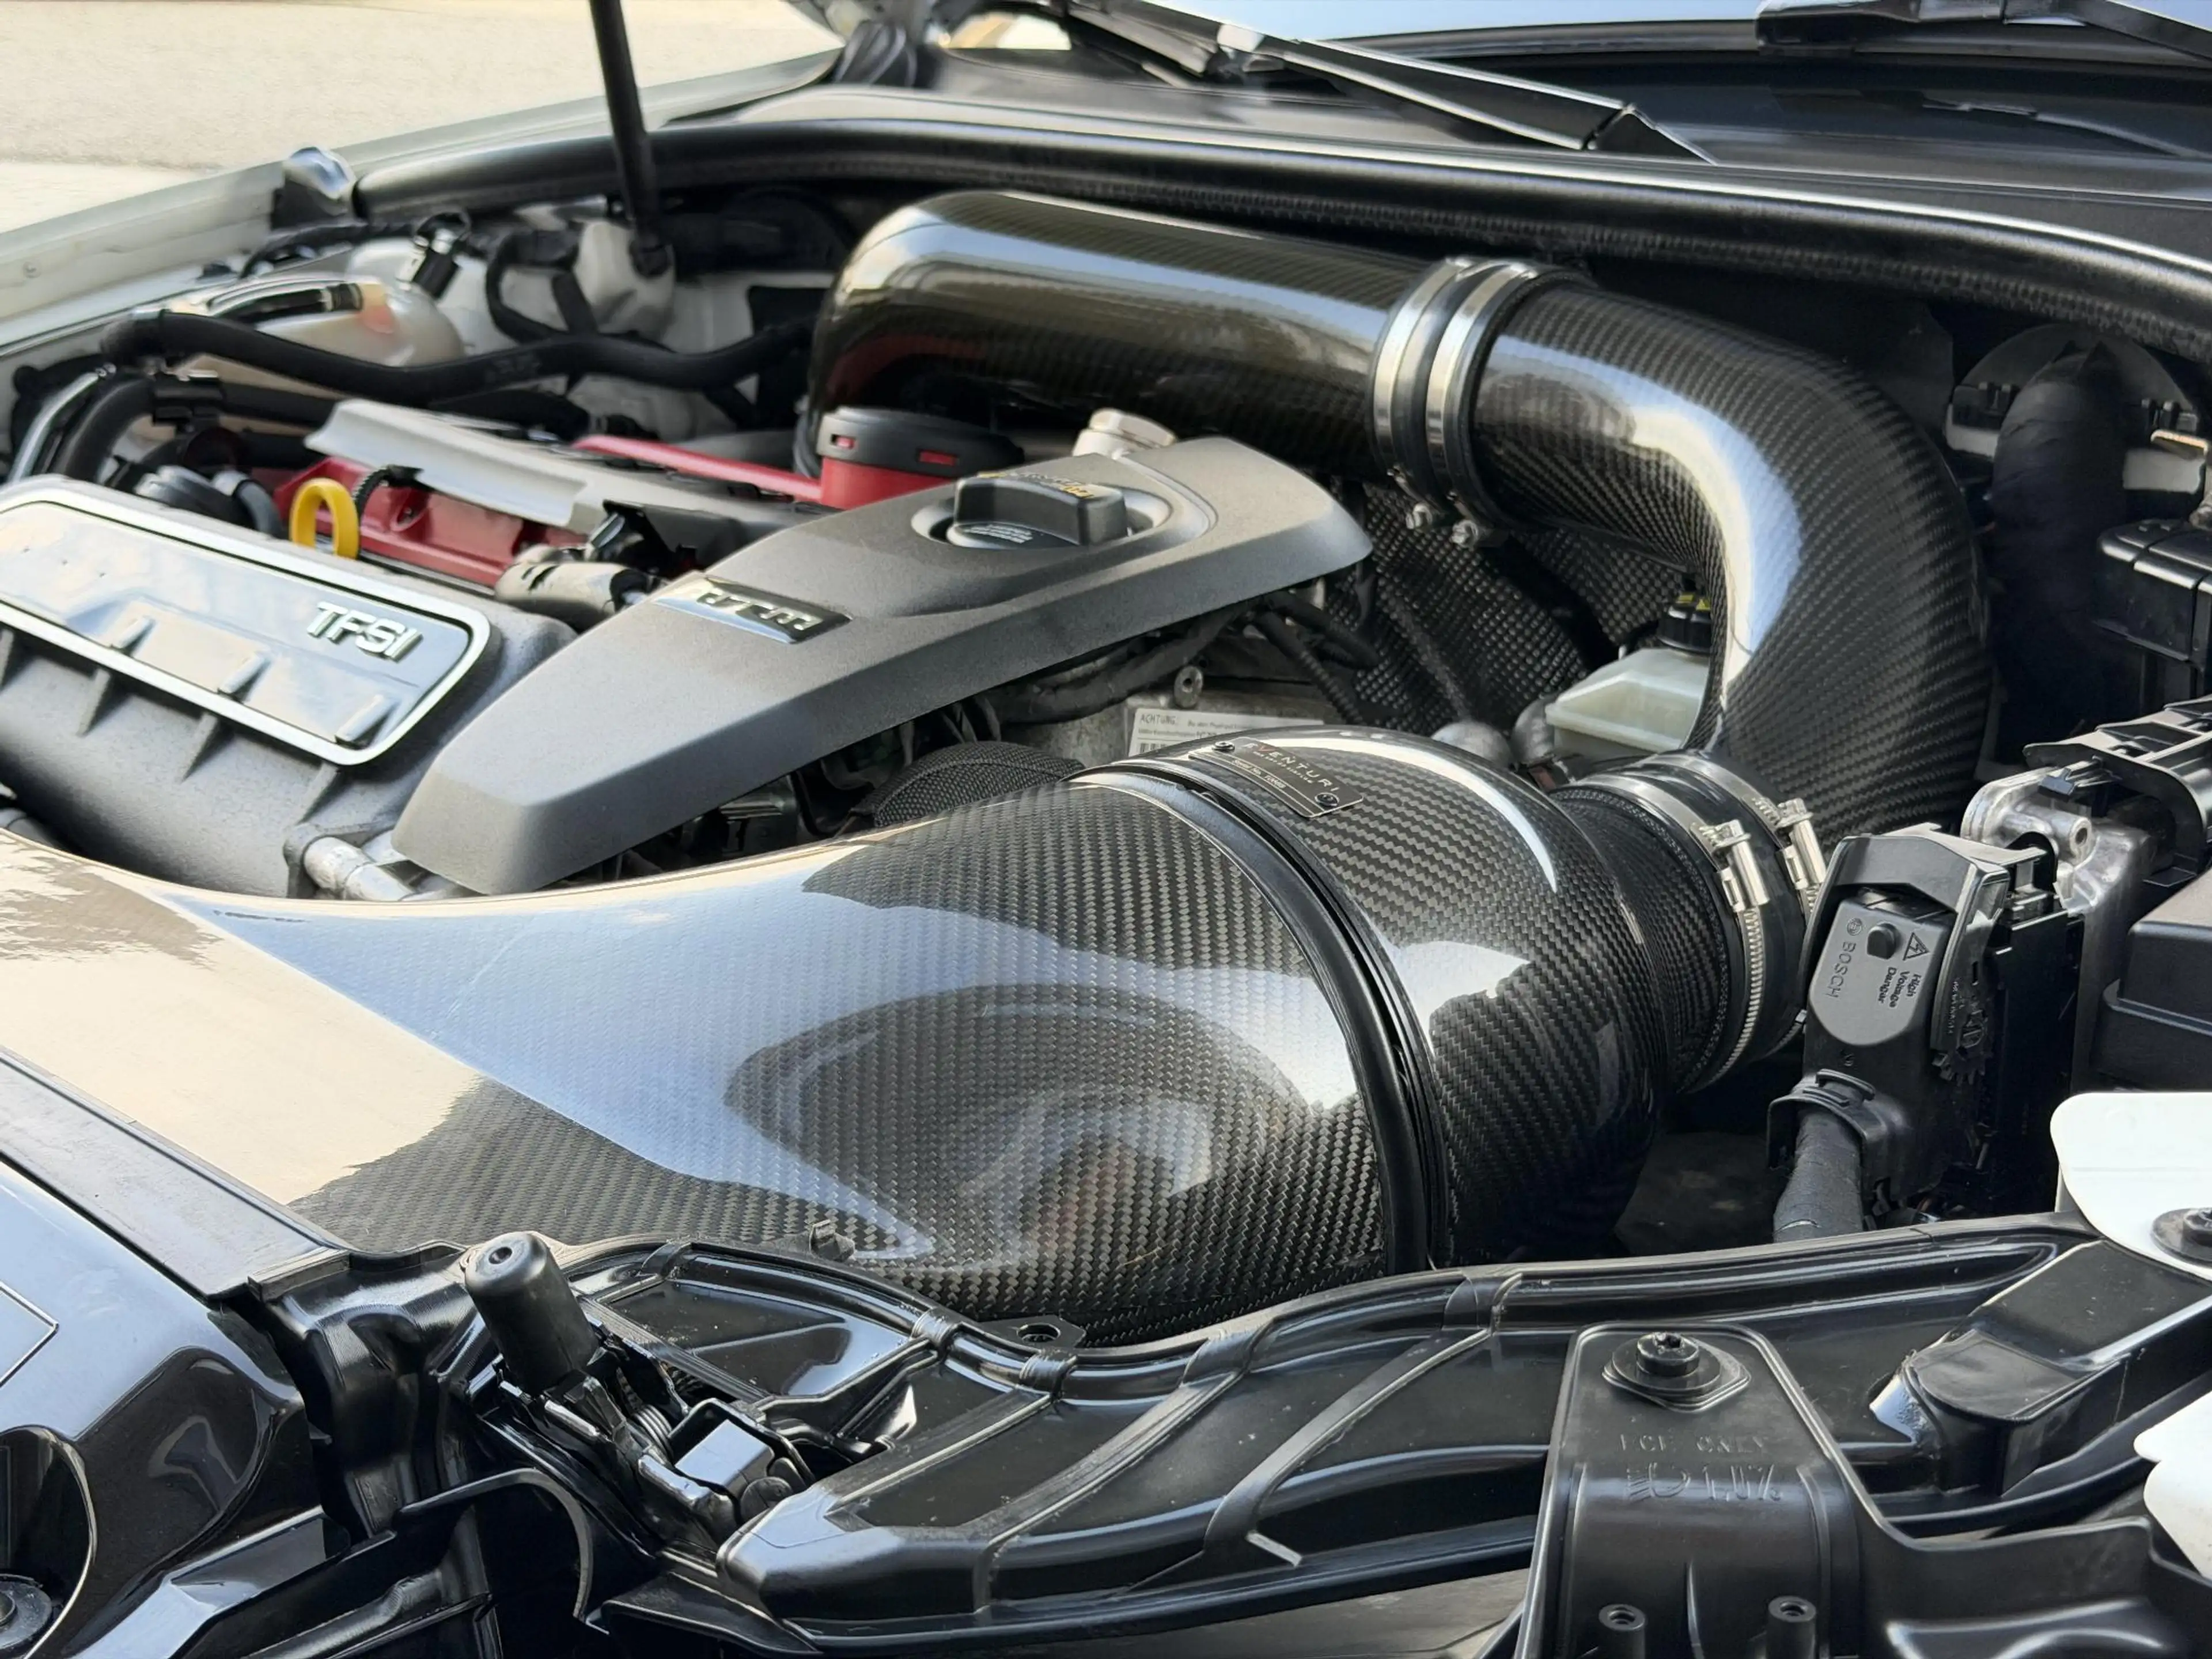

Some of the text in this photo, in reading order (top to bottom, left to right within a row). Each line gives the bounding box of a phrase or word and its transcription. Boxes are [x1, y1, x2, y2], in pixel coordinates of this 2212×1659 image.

[307, 601, 423, 663] TFSI
[1825, 941, 1856, 998] BOSCH
[1878, 967, 1897, 1003] Danger
[1906, 974, 1922, 997] High
[1889, 971, 1910, 1007] Voltage
